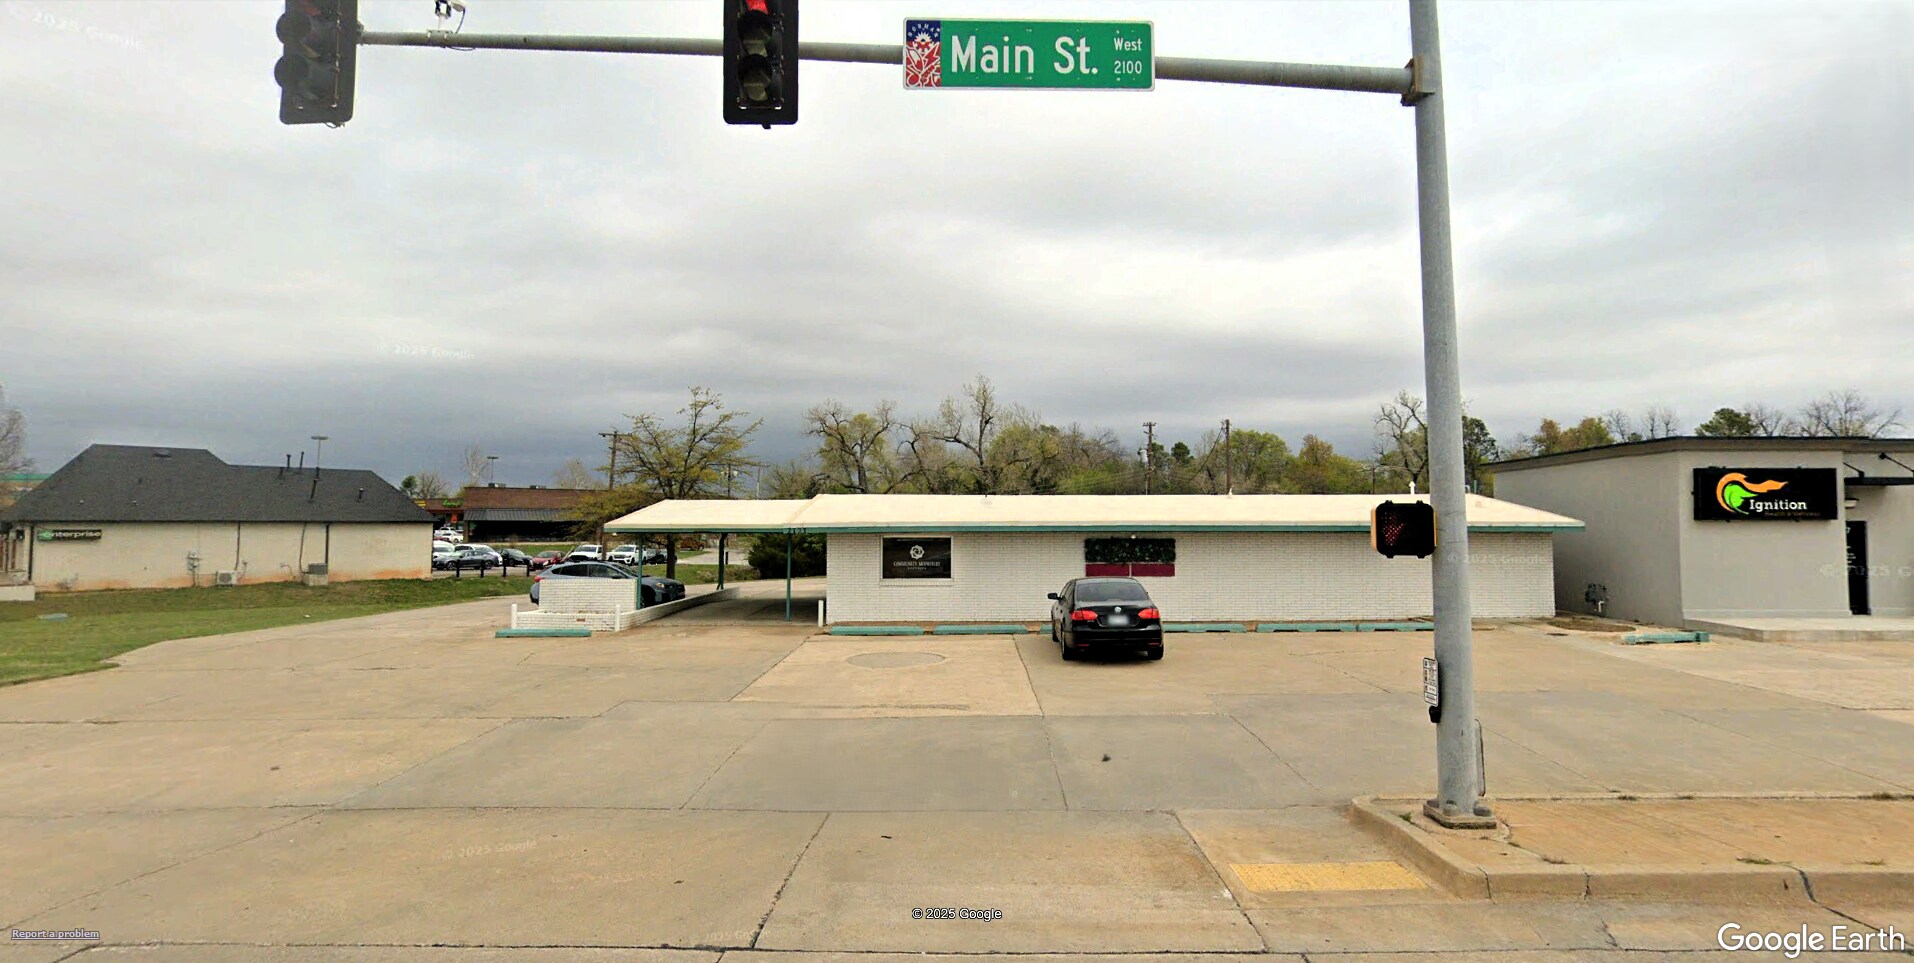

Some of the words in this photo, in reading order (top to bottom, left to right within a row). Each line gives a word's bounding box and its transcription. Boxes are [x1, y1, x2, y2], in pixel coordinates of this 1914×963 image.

[1113, 37, 1143, 52] West
[951, 35, 1035, 74] Main
[1053, 36, 1099, 75] St.
[1114, 60, 1143, 75] 2100
[1749, 498, 1807, 512] Ignition
[41, 530, 102, 538] enterprise
